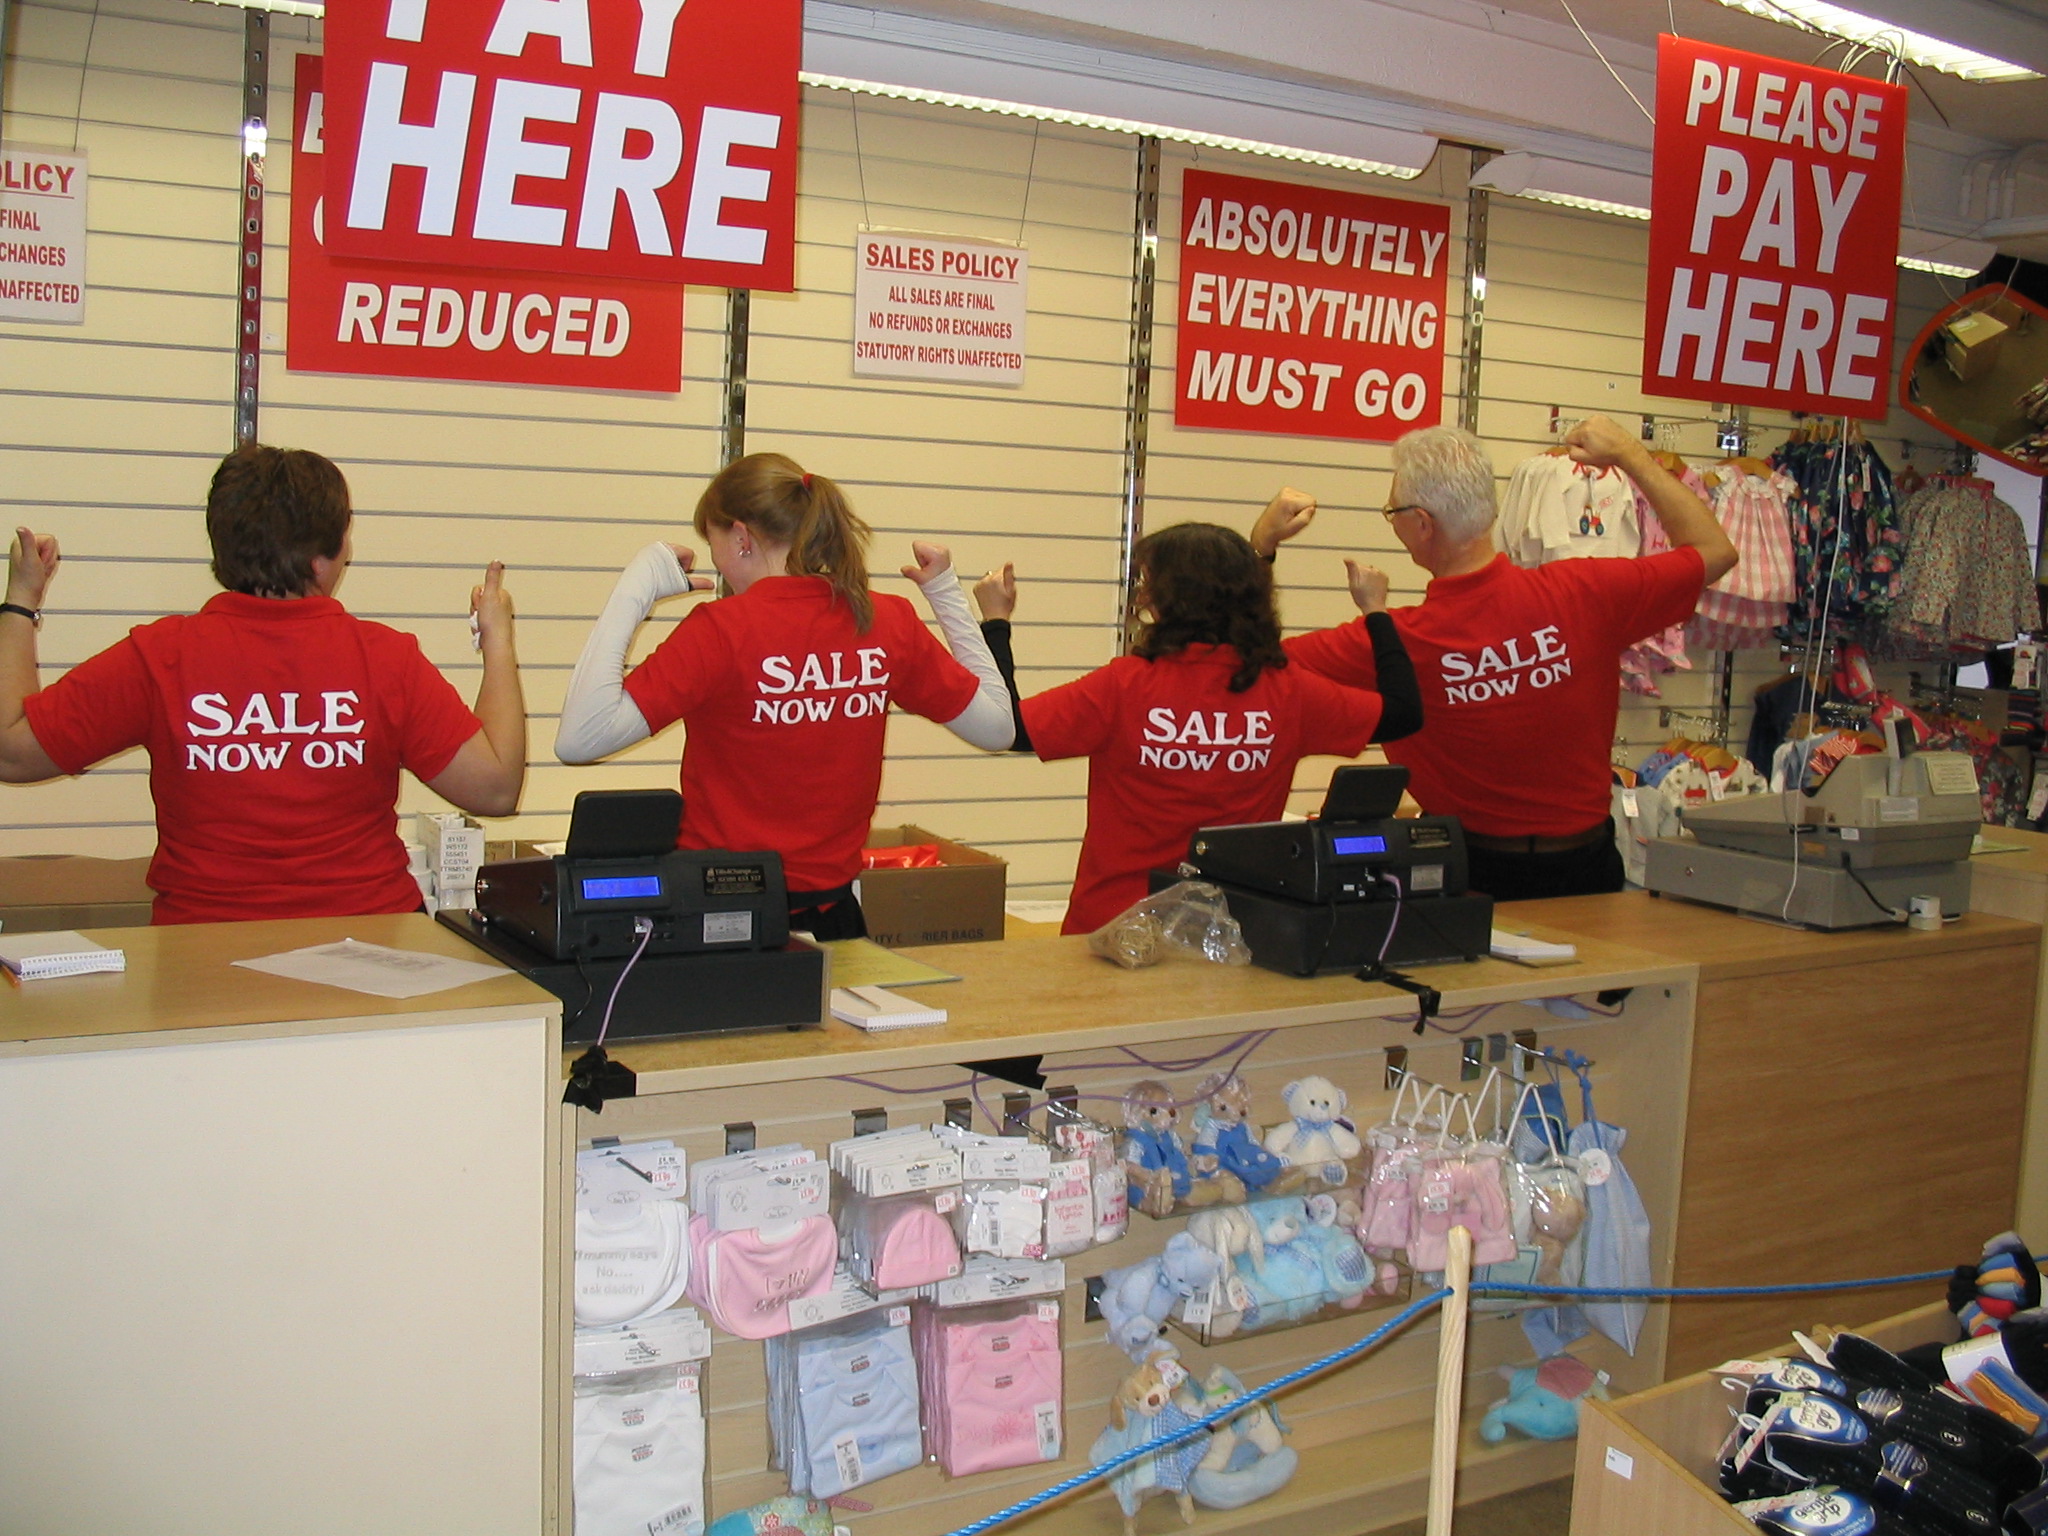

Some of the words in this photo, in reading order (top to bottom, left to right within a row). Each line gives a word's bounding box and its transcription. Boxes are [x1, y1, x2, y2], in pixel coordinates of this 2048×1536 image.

[1686, 59, 1883, 159] PLEASE
[347, 62, 782, 265] HERE
[1691, 145, 1866, 274] PAY
[866, 243, 935, 272] SALES
[942, 250, 1019, 280] POLICY
[1187, 198, 1446, 279] ABSOLUTELY
[338, 282, 630, 357] REDUCED
[888, 285, 908, 303] ALL
[910, 287, 942, 307] SALES
[944, 290, 964, 308] ARE
[966, 293, 995, 311] FINAL
[1188, 273, 1438, 349] EVERYTHING
[869, 311, 884, 329] NO
[886, 313, 933, 333] REFUNDS
[936, 318, 950, 334] OR
[952, 319, 1012, 340] EXCHANGES
[1659, 267, 1888, 400] HERE
[857, 341, 916, 361] STATUTORY
[917, 346, 955, 365] RIGHTS
[957, 349, 1022, 370] UNAFFECTED
[1188, 350, 1343, 412] MUST
[1355, 369, 1426, 421] GO
[757, 647, 890, 695] SALE
[1442, 626, 1566, 683] SALE
[1446, 674, 1520, 705] NOW
[1530, 658, 1572, 688] ON
[187, 691, 365, 738] SALE
[752, 697, 837, 725] NOW
[844, 691, 888, 718] ON
[1143, 707, 1275, 746] SALE
[186, 742, 292, 772] NOW
[302, 740, 366, 769] ON
[1139, 746, 1221, 771] NOW
[1228, 749, 1271, 772] ON
[951, 928, 985, 940] BAGS
